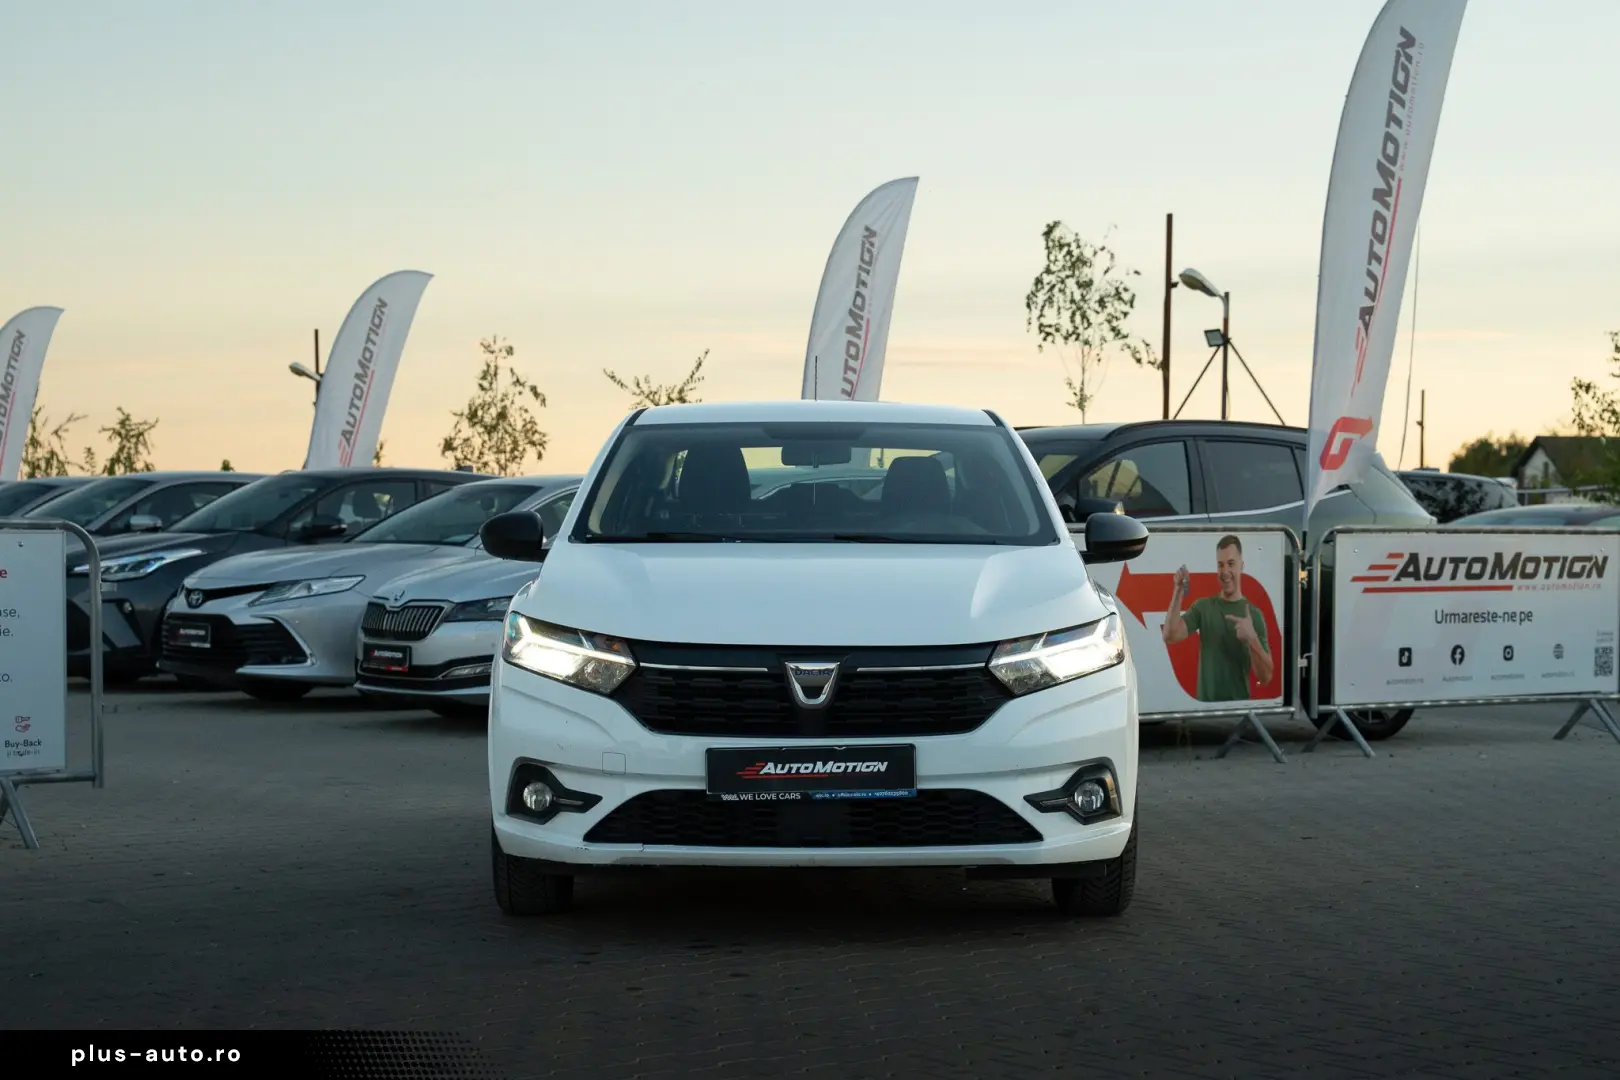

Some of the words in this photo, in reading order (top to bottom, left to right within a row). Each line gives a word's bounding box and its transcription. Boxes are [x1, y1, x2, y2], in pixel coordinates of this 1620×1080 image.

[840, 224, 878, 400] UTOMOTION
[1434, 609, 1517, 625] Urmareste-ne
[1518, 609, 1534, 626] pe
[4, 738, 42, 749] Buy-Back
[739, 793, 754, 801] WE
[755, 793, 777, 801] LOVE
[778, 792, 801, 800] CARS
